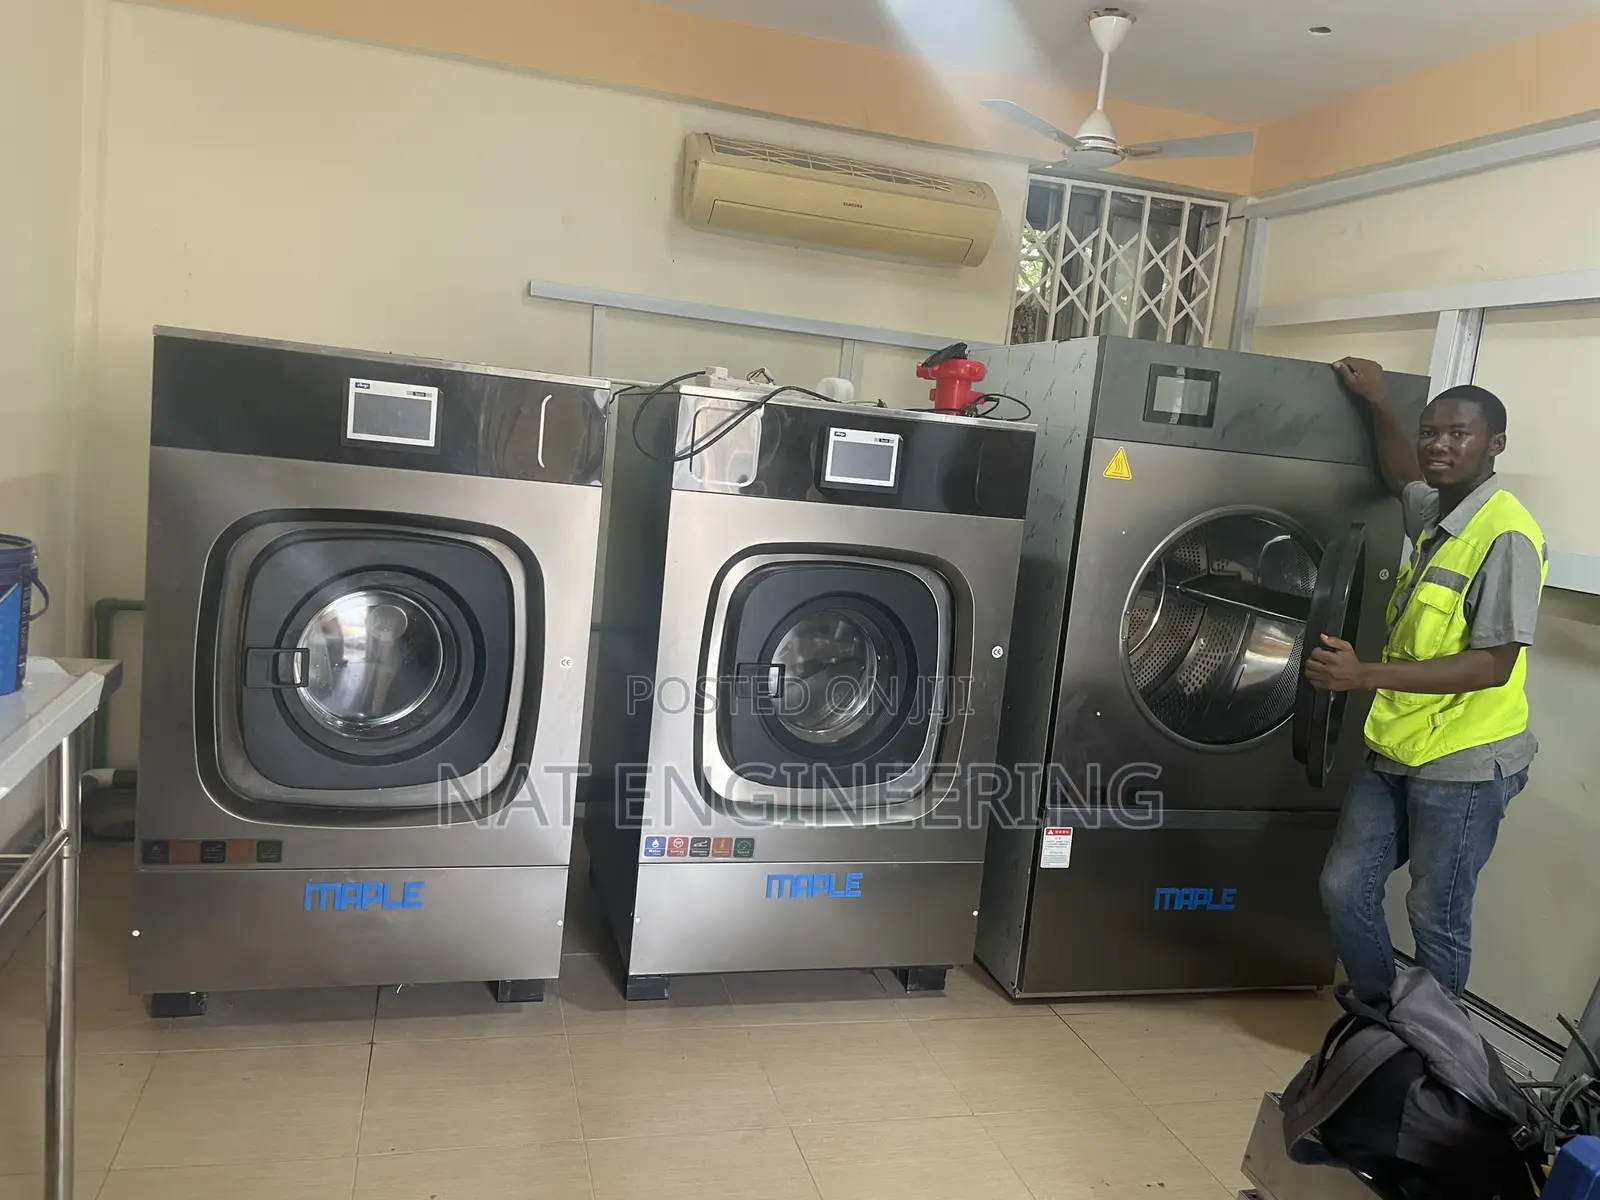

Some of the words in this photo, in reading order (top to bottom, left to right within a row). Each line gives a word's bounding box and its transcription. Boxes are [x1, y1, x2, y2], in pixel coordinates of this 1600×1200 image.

[304, 881, 425, 911] MAPLE
[765, 872, 864, 899] MAPLE
[1153, 888, 1237, 910] MAPLE
